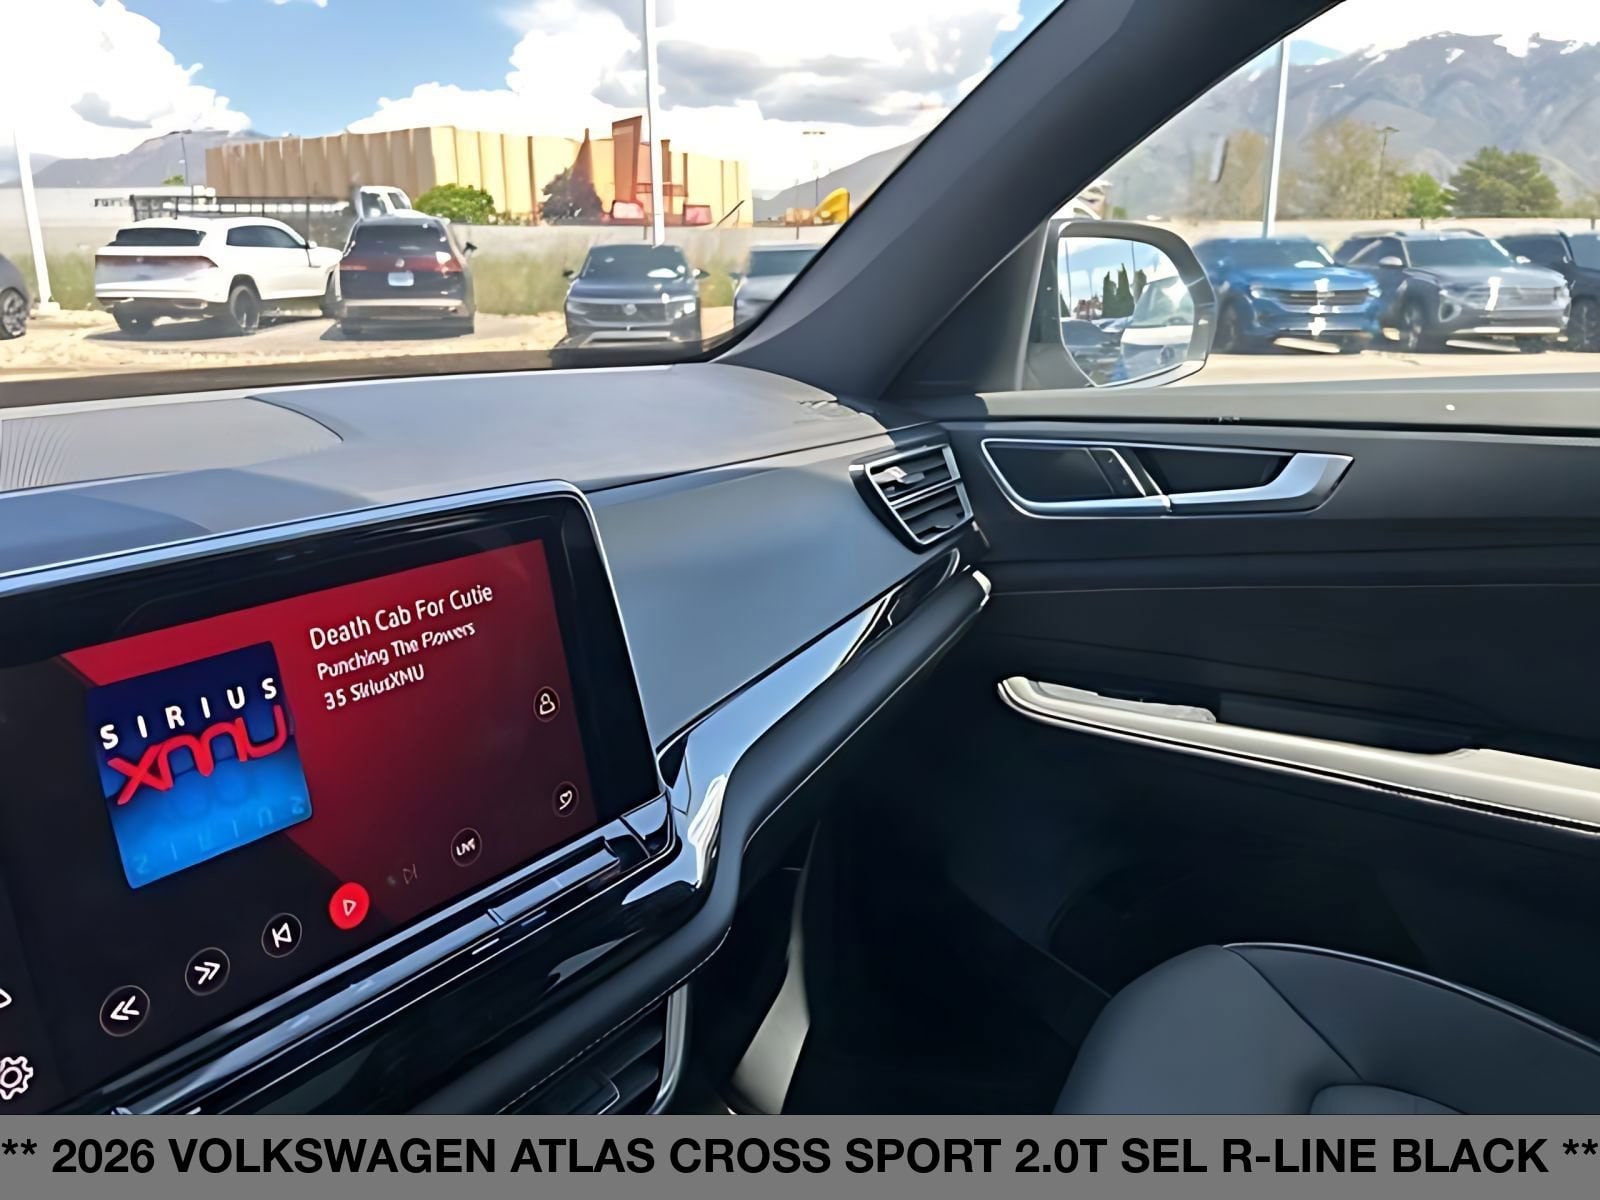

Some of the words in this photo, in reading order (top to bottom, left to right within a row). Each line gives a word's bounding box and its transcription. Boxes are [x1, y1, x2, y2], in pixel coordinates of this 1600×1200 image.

[309, 616, 372, 650] Death
[375, 605, 412, 632] Cab
[415, 597, 445, 621] For
[449, 584, 494, 610] Cutie
[100, 677, 278, 750] SIRIUS
[323, 688, 347, 711] 35
